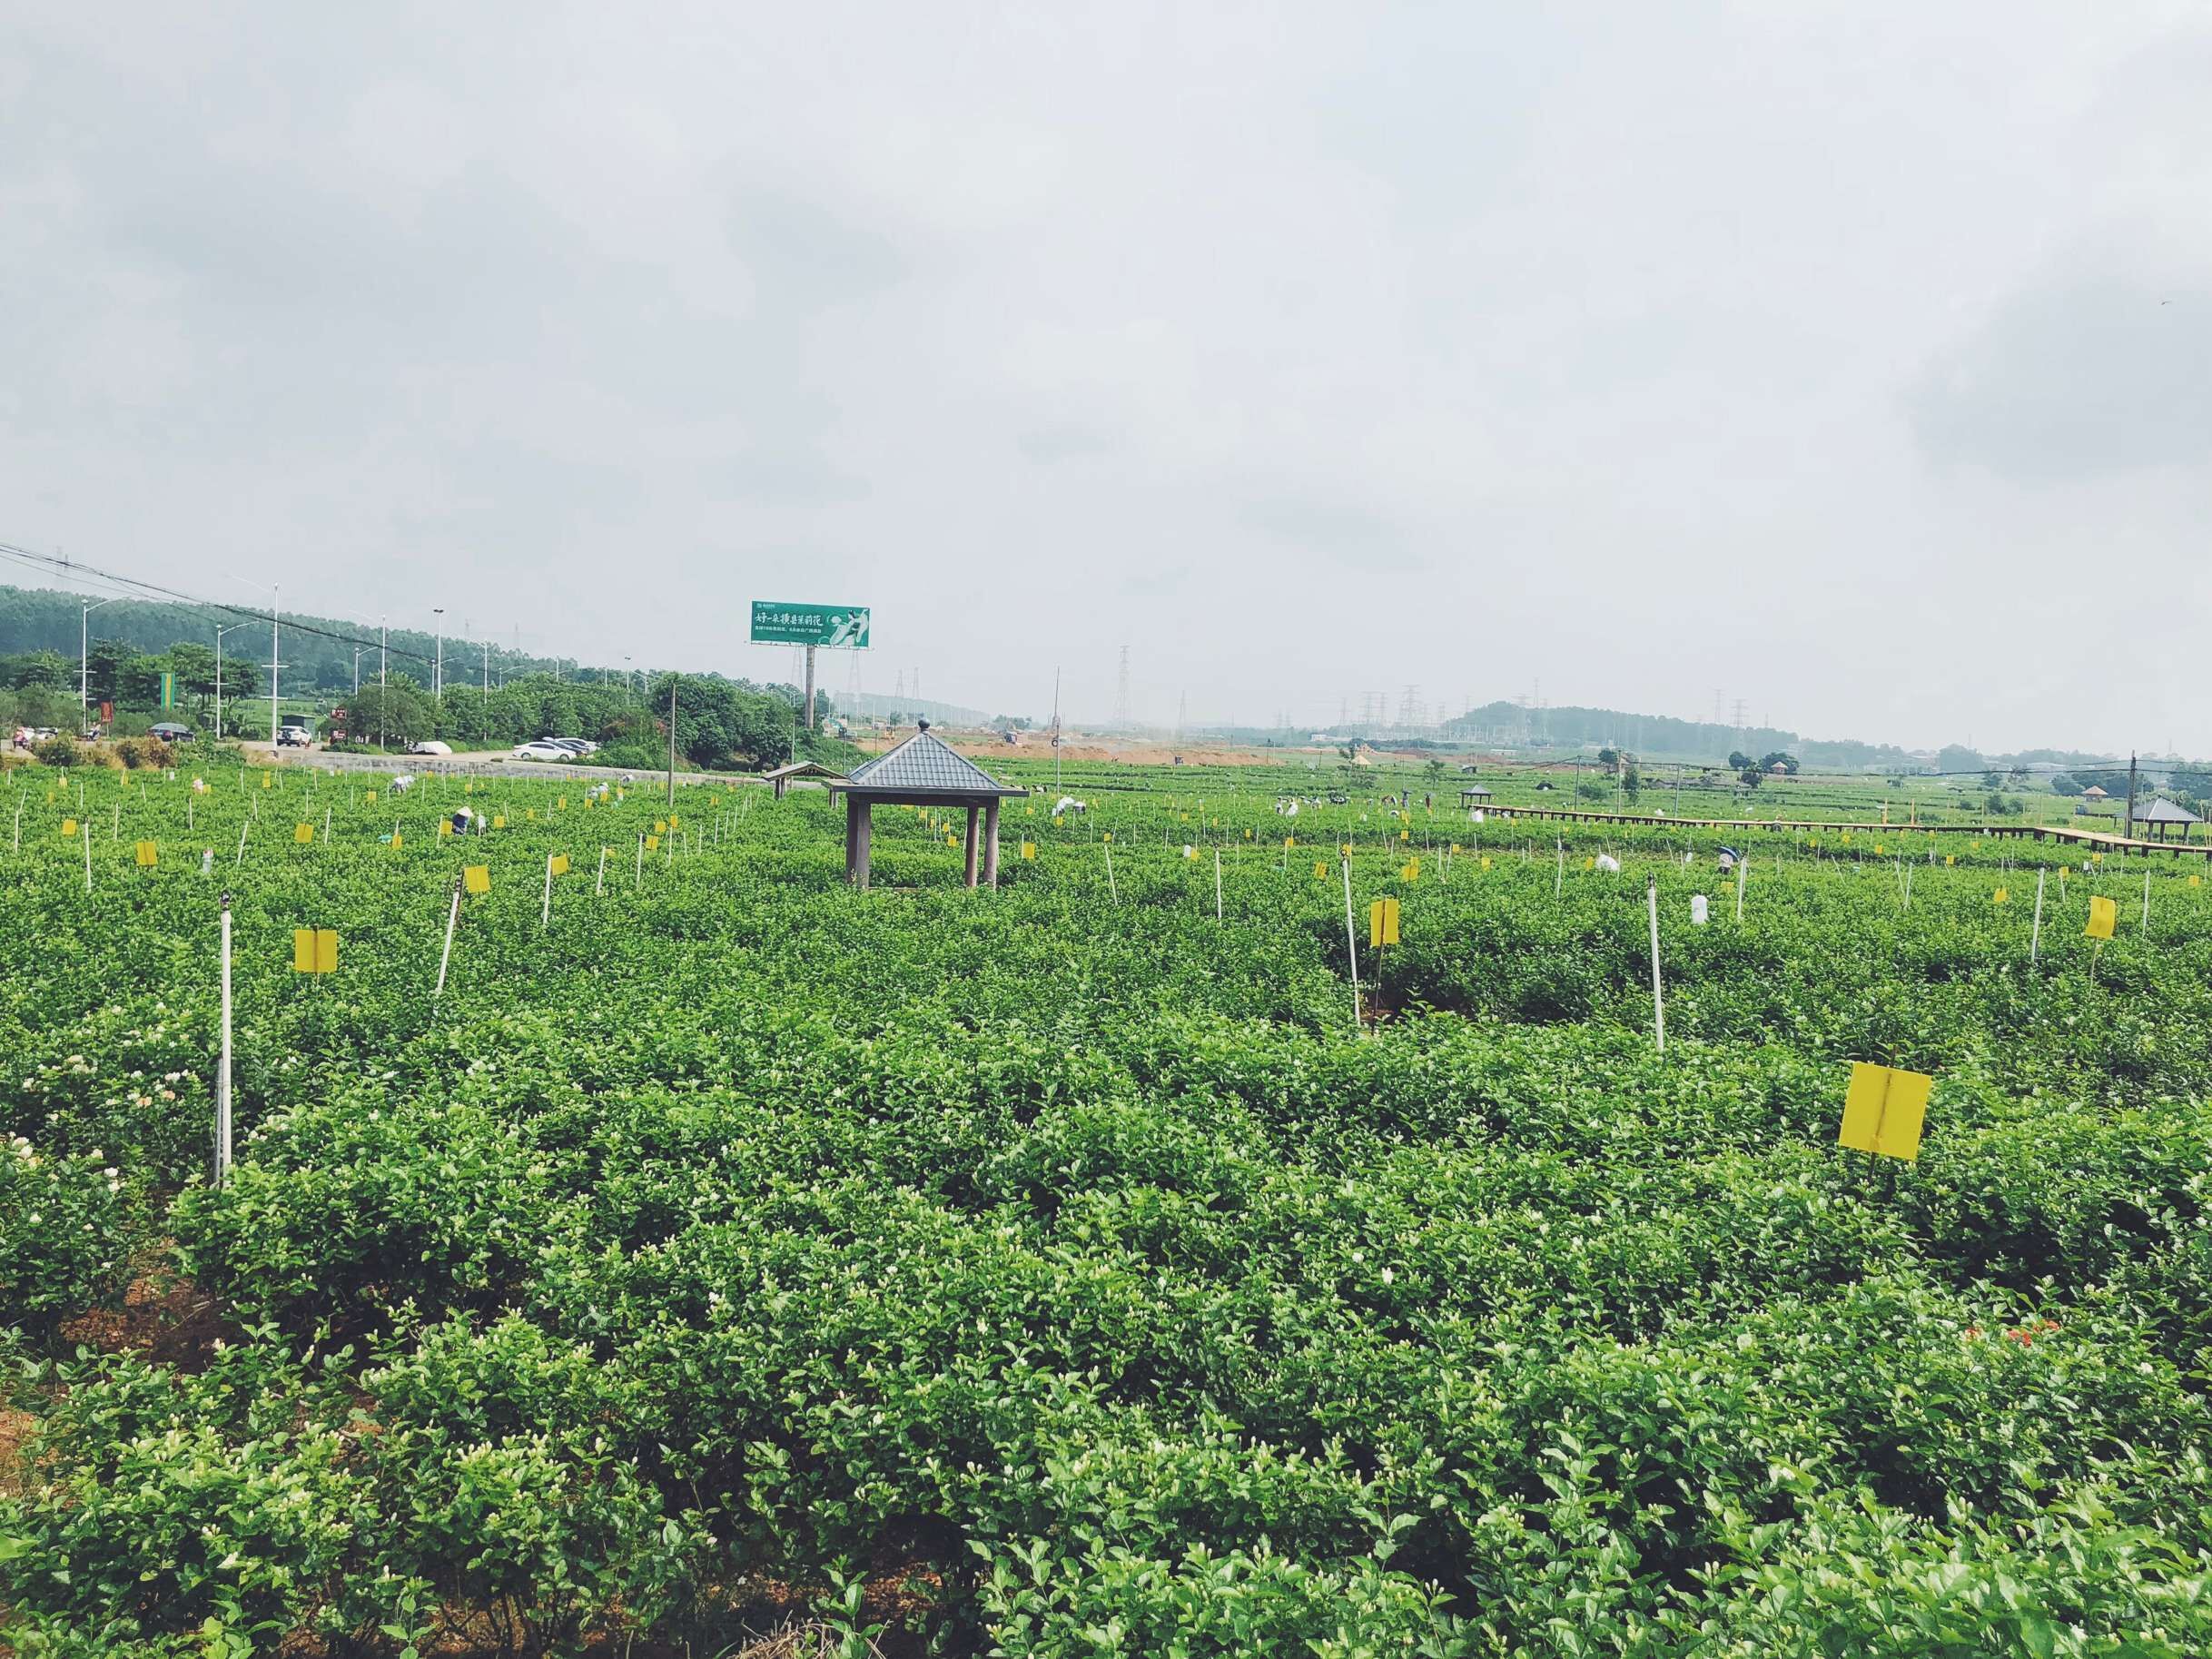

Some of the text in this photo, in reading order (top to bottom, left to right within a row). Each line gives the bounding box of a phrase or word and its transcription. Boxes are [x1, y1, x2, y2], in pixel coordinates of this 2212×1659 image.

[755, 612, 824, 627] 好一朵横县茉莉花
